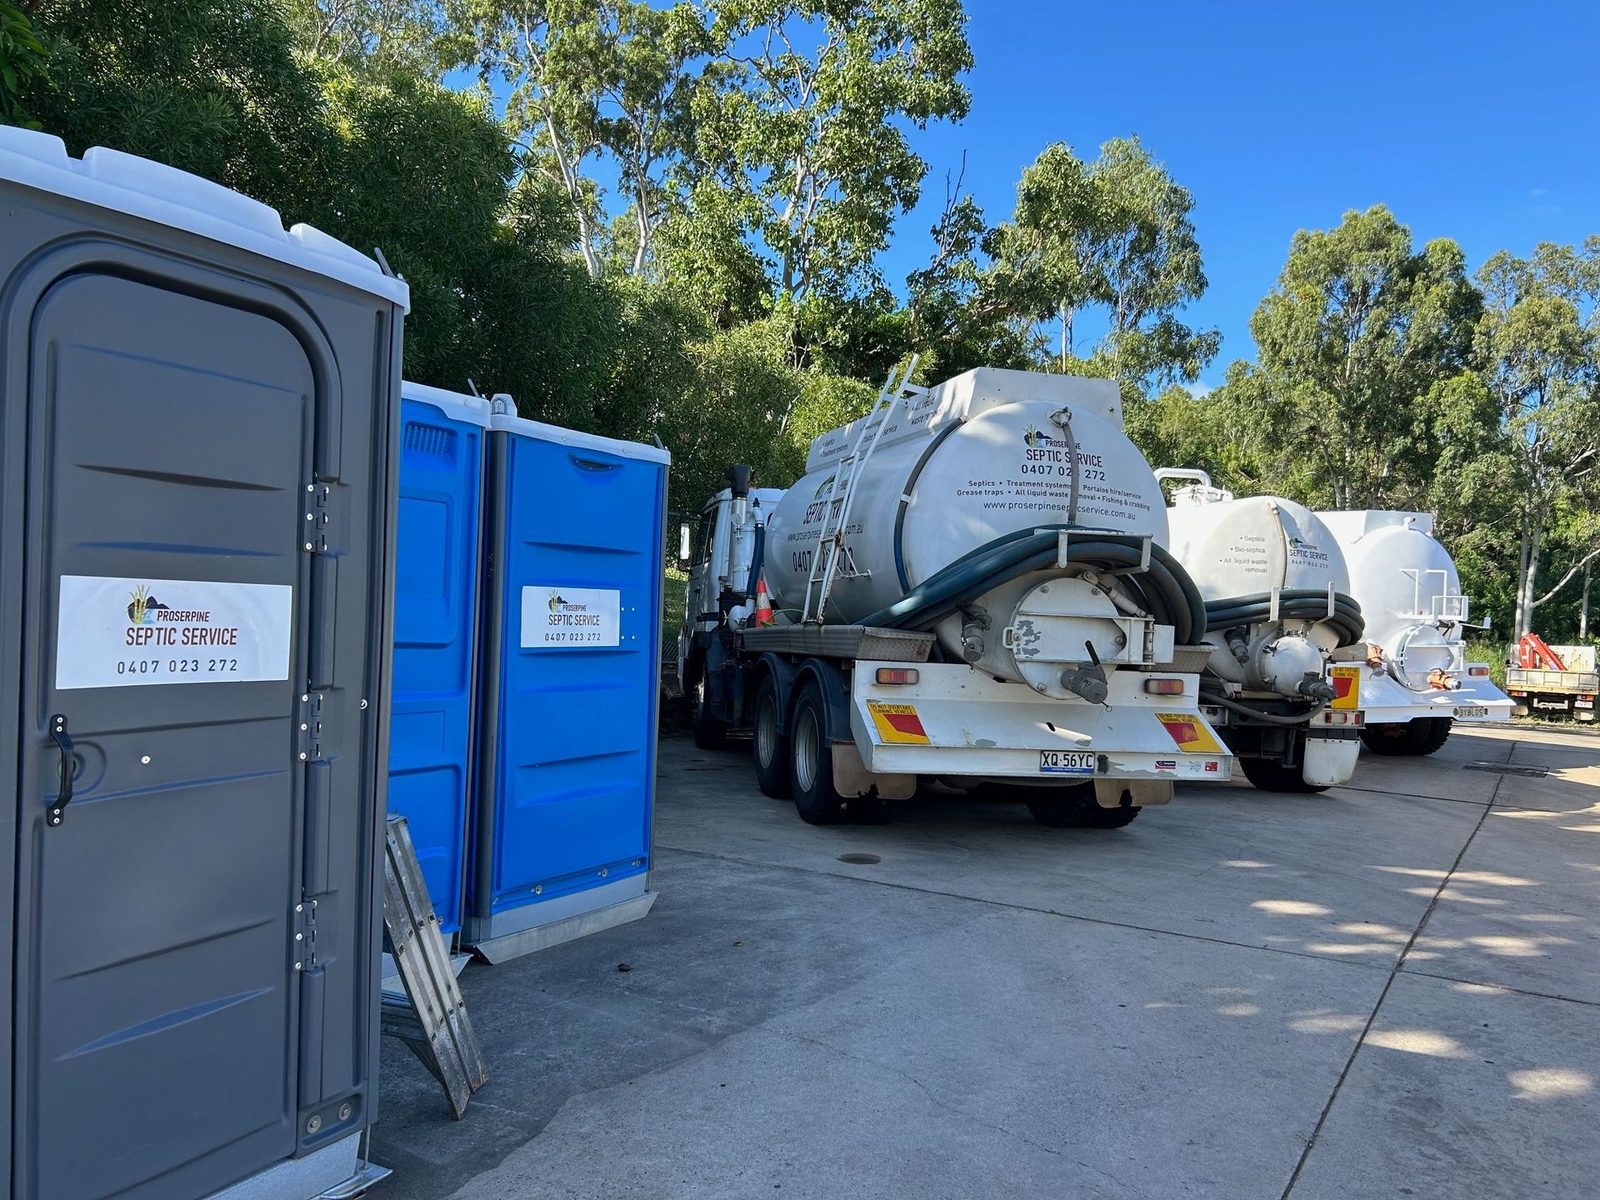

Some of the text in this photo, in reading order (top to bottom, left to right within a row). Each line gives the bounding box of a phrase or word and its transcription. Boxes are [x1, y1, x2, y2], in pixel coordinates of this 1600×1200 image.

[1045, 440, 1081, 450] PROSERNE
[1026, 449, 1103, 467] SEPTIC SRVICE
[1021, 464, 1106, 481] 0407 02 272
[968, 480, 996, 488] Septics
[1006, 479, 1044, 487] Treatment
[984, 489, 1004, 497] traps
[1026, 489, 1047, 497] liquid
[1077, 493, 1096, 501] moval
[1102, 496, 1123, 506] Fishing
[1129, 501, 1150, 511] crabbing
[1290, 549, 1328, 561] SEPTIC SERVICE
[792, 551, 812, 572] 0407
[562, 604, 587, 612] PROSERPINE
[157, 610, 210, 622] PROSERPINE
[548, 614, 600, 626] SEPTIC SERVICE
[126, 627, 238, 646] SEPTIC SERVICE
[544, 632, 601, 641] 0407 023 272
[117, 659, 237, 674] 0407 023 272
